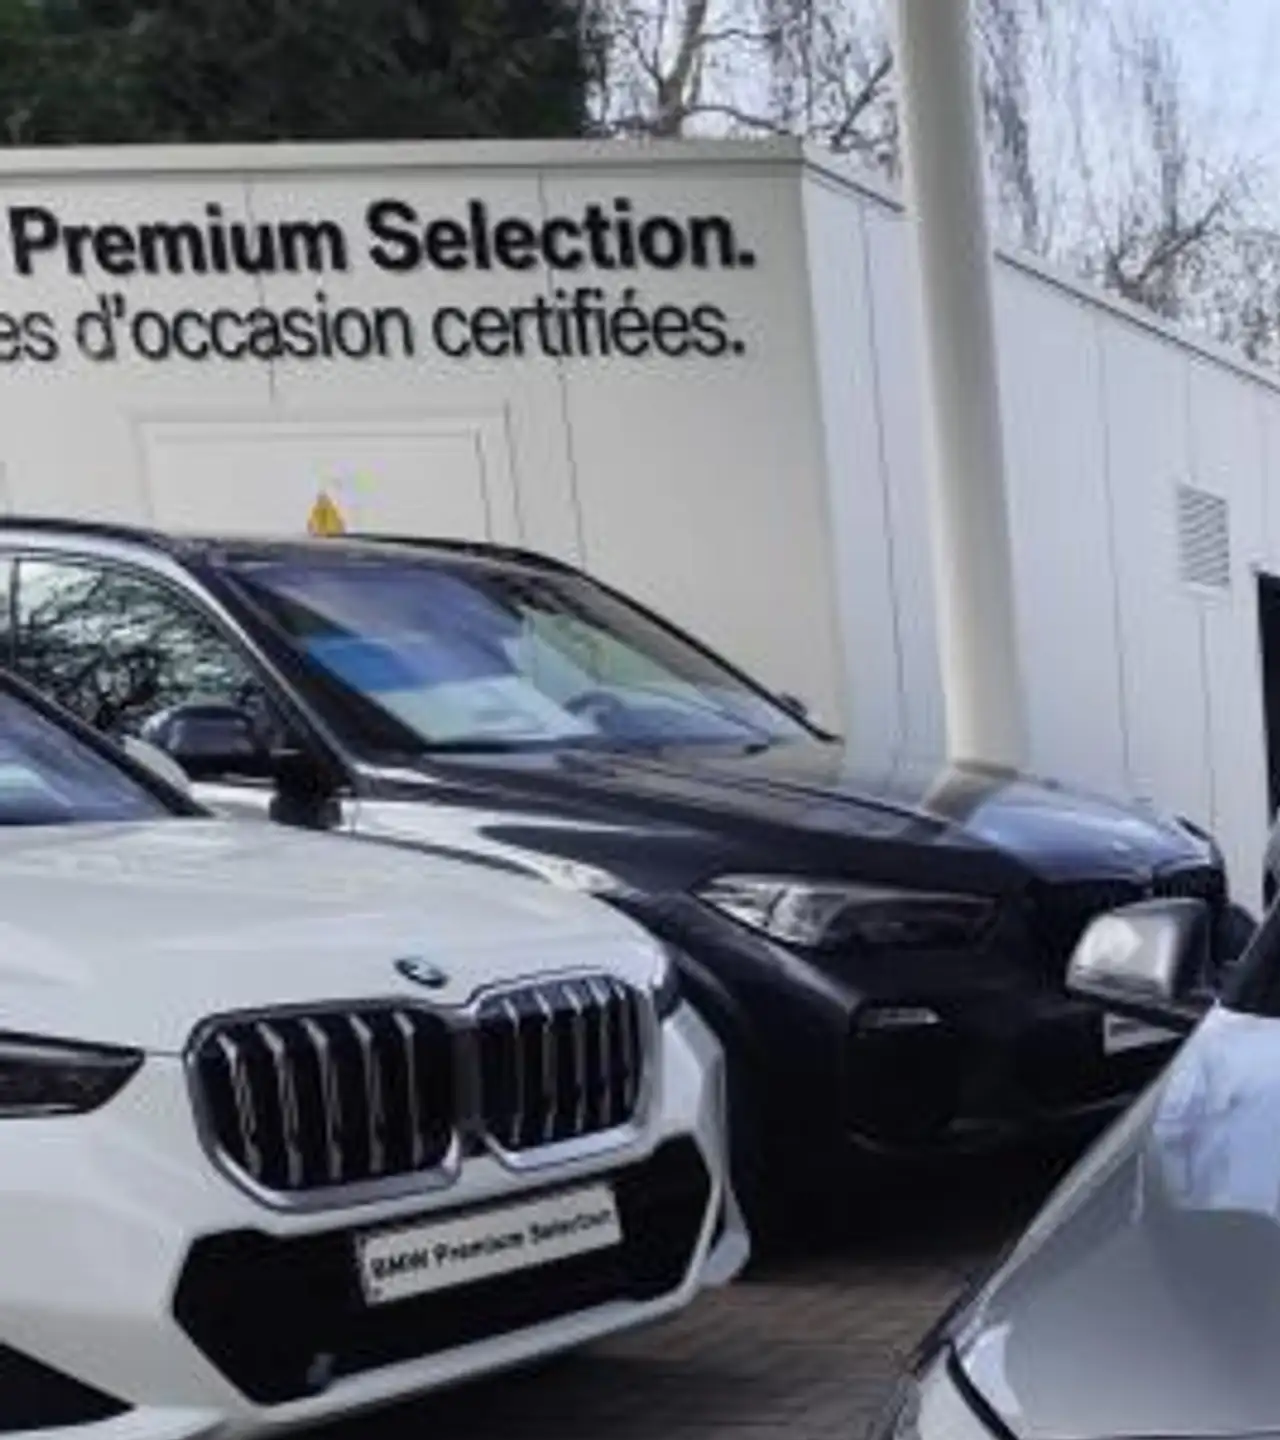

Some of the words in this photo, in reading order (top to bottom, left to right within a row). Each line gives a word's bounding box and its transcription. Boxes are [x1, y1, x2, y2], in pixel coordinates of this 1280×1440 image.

[8, 202, 349, 277] Premium
[365, 196, 758, 274] Selection.
[75, 290, 415, 362] d'occasion
[431, 286, 747, 359] certifiées.
